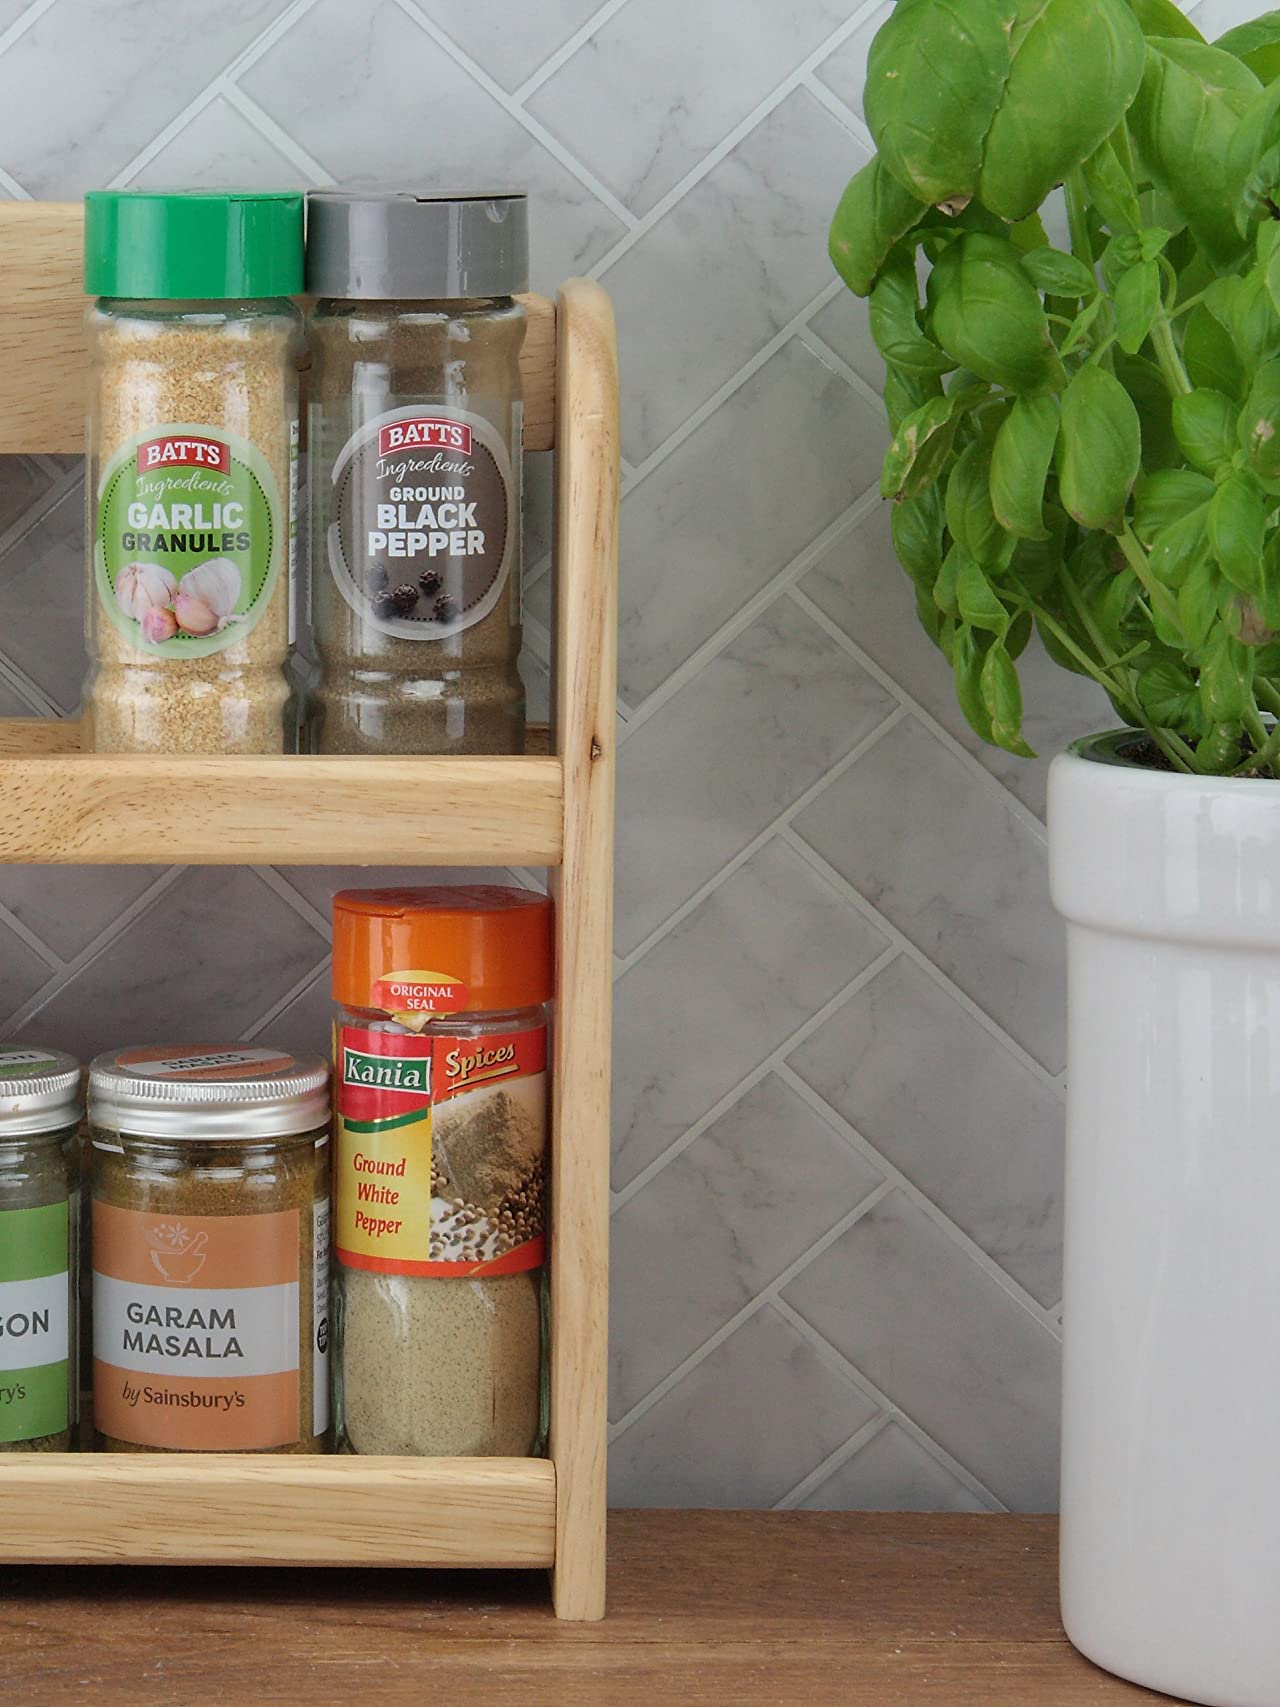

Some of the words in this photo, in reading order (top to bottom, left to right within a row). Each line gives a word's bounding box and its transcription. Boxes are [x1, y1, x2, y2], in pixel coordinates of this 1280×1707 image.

[388, 423, 463, 448] BATTS
[146, 442, 221, 466] BATTS
[376, 452, 475, 483] Ingredients
[136, 471, 235, 501] Ingredients
[389, 486, 465, 502] GROUND
[127, 501, 244, 530] GARLIC
[377, 502, 478, 529] BLACK
[121, 531, 251, 553] GRANULES
[368, 529, 486, 557] PEPPER
[390, 984, 454, 999] ORIGINAL
[406, 998, 436, 1011] SEAL
[346, 1056, 422, 1088] Kania
[445, 1043, 517, 1079] Spices
[353, 1152, 407, 1177] Ground
[357, 1182, 400, 1206] White
[354, 1210, 402, 1238] Pepper
[126, 1302, 237, 1330] GARAM
[122, 1329, 244, 1358] MASALA
[122, 1380, 141, 1407] by
[143, 1386, 246, 1412] Sainsbury's
